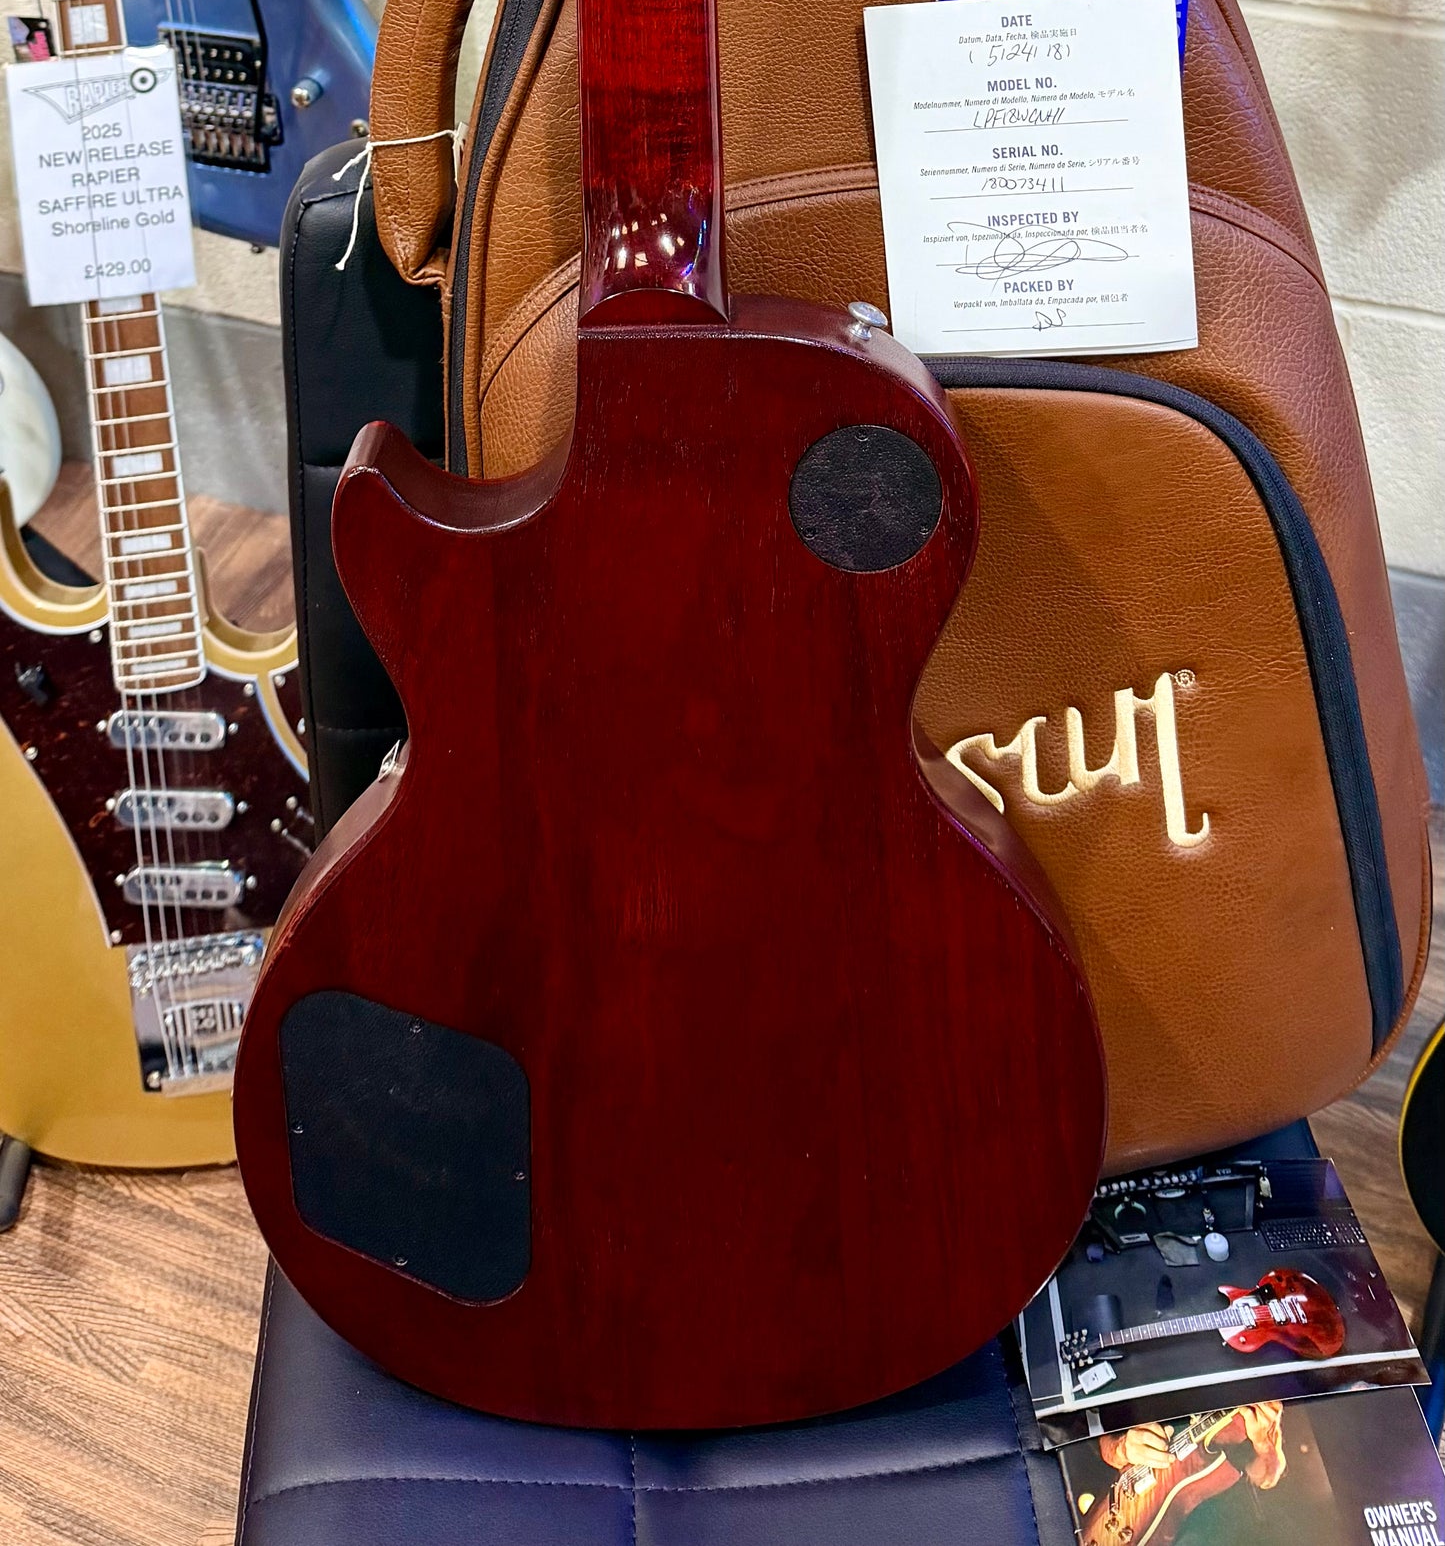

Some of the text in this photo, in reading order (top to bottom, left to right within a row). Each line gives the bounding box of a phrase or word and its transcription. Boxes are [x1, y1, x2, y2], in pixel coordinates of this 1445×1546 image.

[1001, 14, 1032, 28] DATE
[958, 35, 983, 45] Datum,
[985, 34, 1004, 43] Data,
[1006, 32, 1028, 41] Fecha,
[987, 76, 1057, 93] MODEL NO.
[65, 79, 131, 118] RAPIER
[913, 101, 961, 110] Modelnummer,
[964, 98, 991, 107] Numero
[992, 97, 999, 105] di
[1001, 95, 1029, 104] Modello,
[1069, 91, 1095, 100] Modelo,
[82, 122, 123, 141] 2025
[39, 140, 173, 168] NEW RELEASE
[992, 144, 1063, 160] SERIAL NO.
[72, 167, 140, 188] RAPIER
[919, 167, 970, 177] Seriennummer,
[971, 165, 998, 174] Numero
[999, 164, 1006, 172] di
[1008, 163, 1027, 172] Serie,
[1067, 160, 1087, 168] Serie,
[981, 176, 1064, 193] 180073411
[38, 186, 184, 215] SAFFIRE ULTRA
[51, 209, 175, 237] Shoreline Gold
[987, 211, 1079, 227] INSPECTED BY
[923, 235, 954, 244] Inspiziert
[955, 234, 970, 242] von,
[1076, 228, 1089, 237] por,
[84, 258, 151, 280] £429.00
[1003, 279, 1074, 293] PACKED BY
[953, 300, 982, 309] Verpackt
[984, 300, 998, 308] von,
[1000, 298, 1033, 307] Imballata
[1034, 297, 1046, 305] da,
[1047, 296, 1084, 305] Empacada
[1085, 296, 1098, 304] por,
[1363, 1500, 1437, 1529] OWNER'S
[1370, 1524, 1445, 1546] MANUAL
